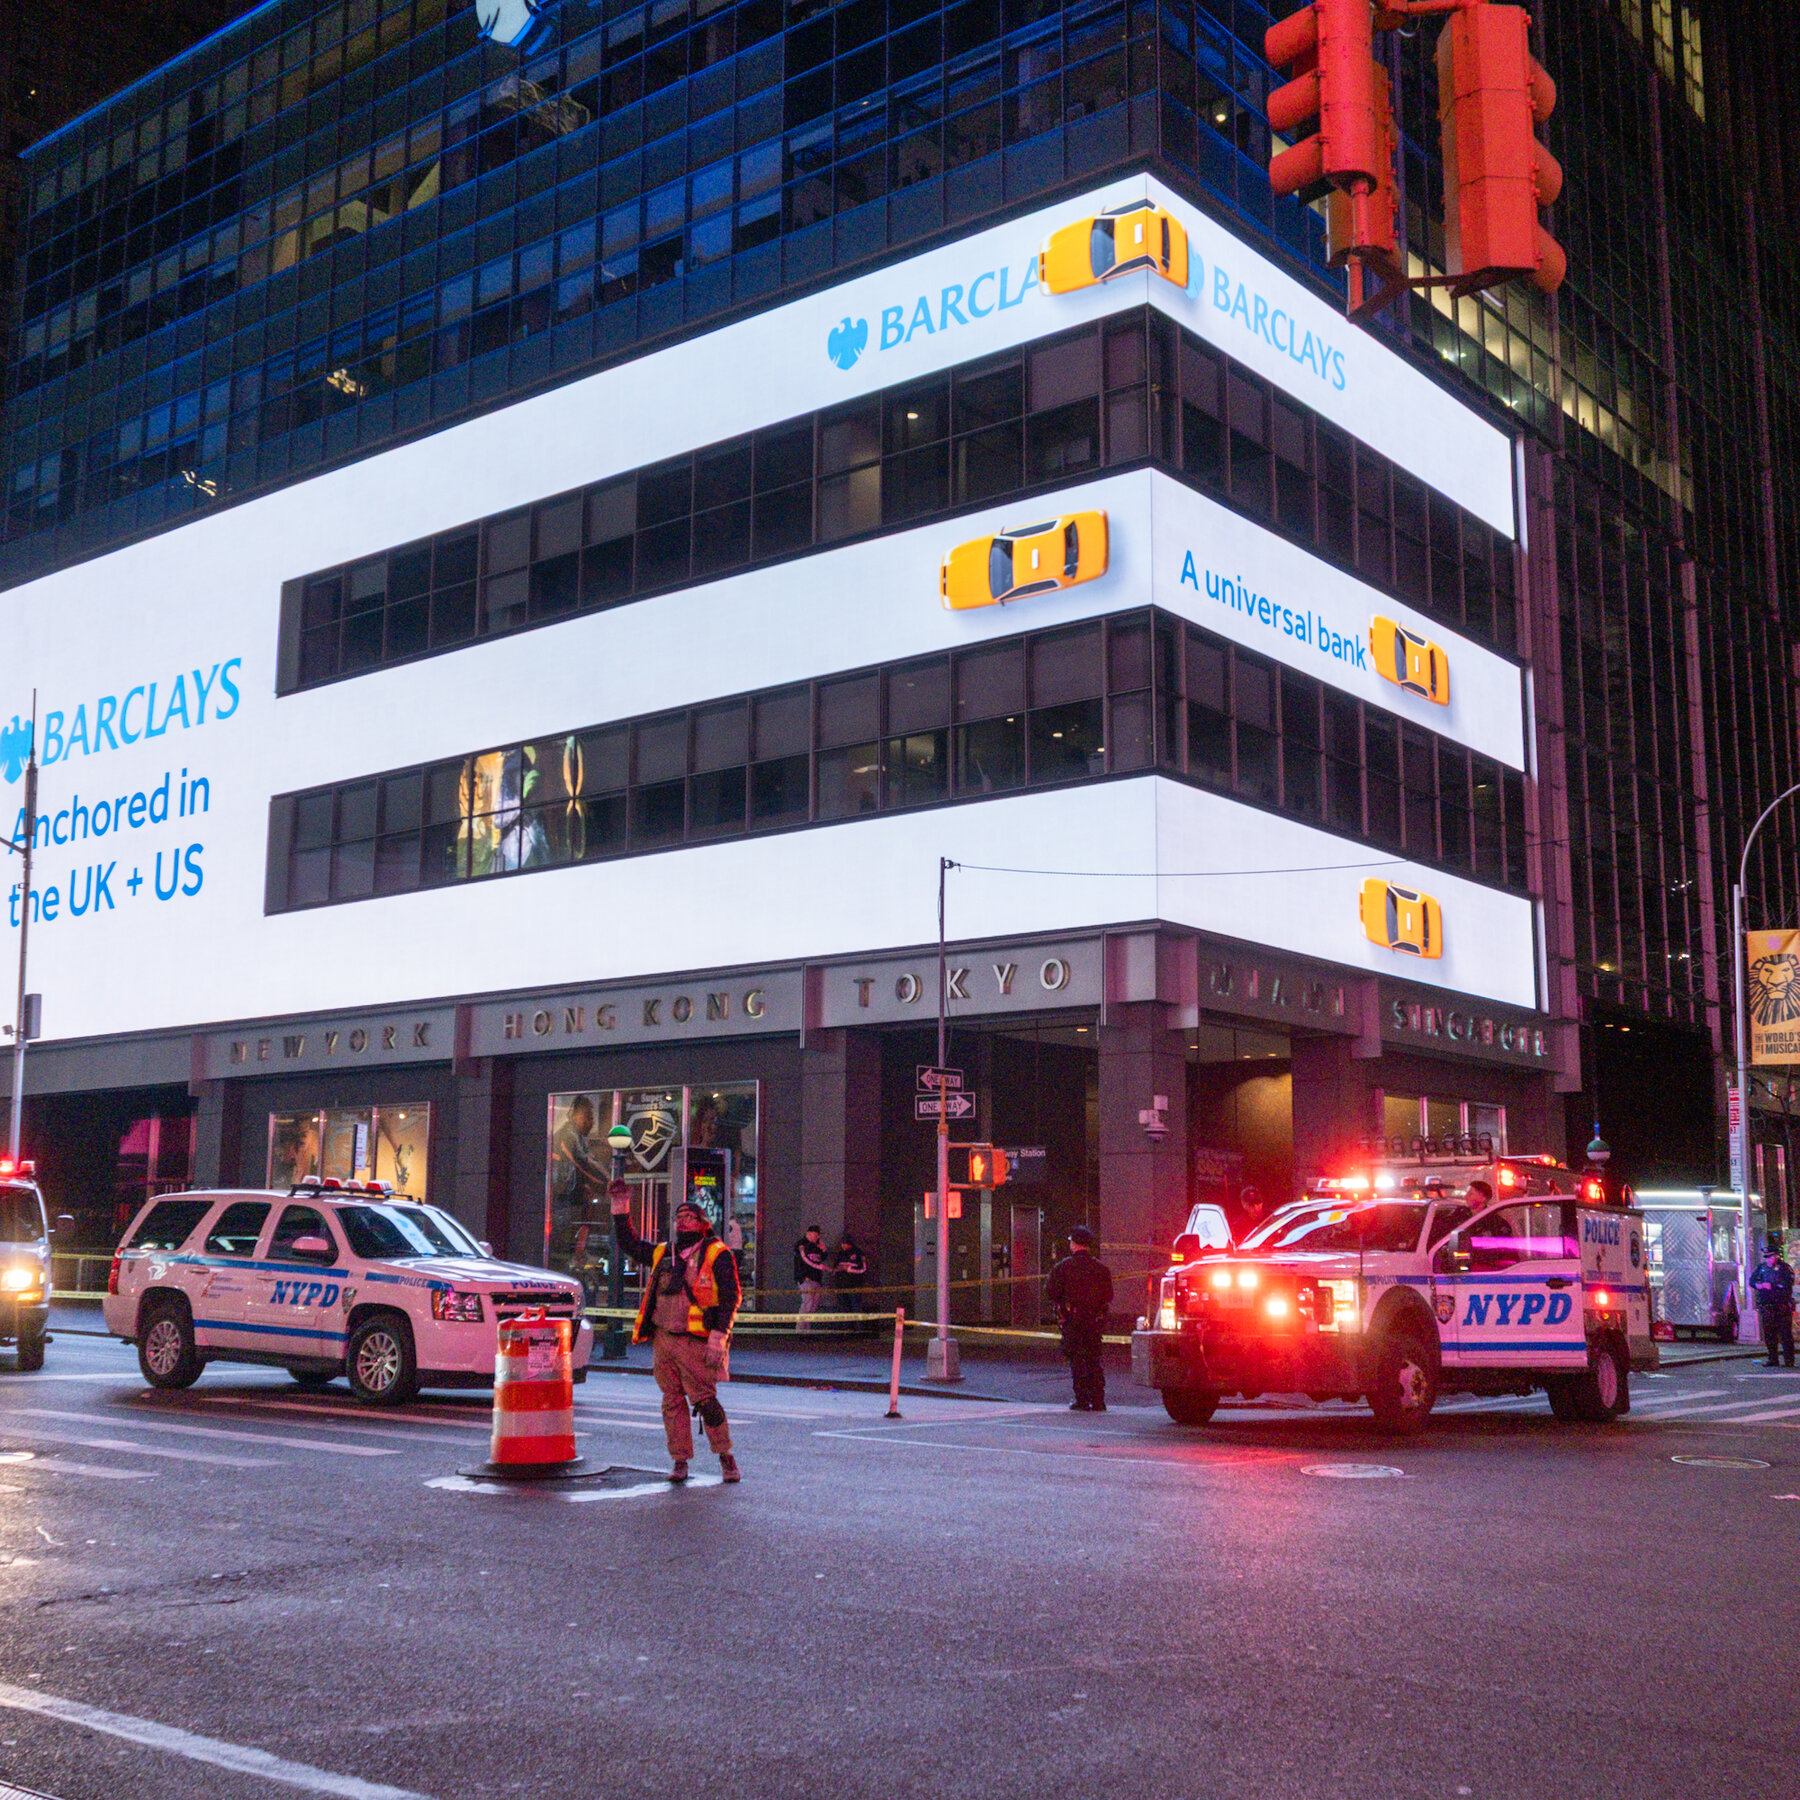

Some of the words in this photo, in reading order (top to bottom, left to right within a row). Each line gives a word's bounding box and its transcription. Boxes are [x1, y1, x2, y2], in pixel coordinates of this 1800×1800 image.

[880, 256, 1037, 352] BARCLA
[1213, 266, 1346, 392] BARCLAYS
[1180, 550, 1200, 592] A
[1206, 570, 1313, 646] universal
[1318, 616, 1367, 672] bank
[41, 657, 243, 767] BARCLAYS
[9, 772, 170, 855] Anchored
[179, 768, 210, 817] in
[9, 884, 60, 928] the
[69, 861, 117, 918] UK
[126, 867, 144, 897] +
[155, 843, 205, 902] US
[853, 958, 1071, 1008] TOKYO
[504, 1003, 617, 1040] HONG
[642, 989, 767, 1027] KONG
[230, 1034, 306, 1065] NEW
[325, 1022, 432, 1057] YORK
[1765, 1043, 1800, 1055] MUSICA
[926, 1074, 939, 1084] ONE
[945, 1075, 958, 1086] WAY
[921, 1102, 939, 1112] ONE
[945, 1100, 963, 1111] WAY
[1584, 1219, 1620, 1246] POLICE
[269, 1280, 340, 1308] NYPD
[400, 1276, 428, 1289] POLICE
[1462, 1293, 1573, 1326] NYPD
